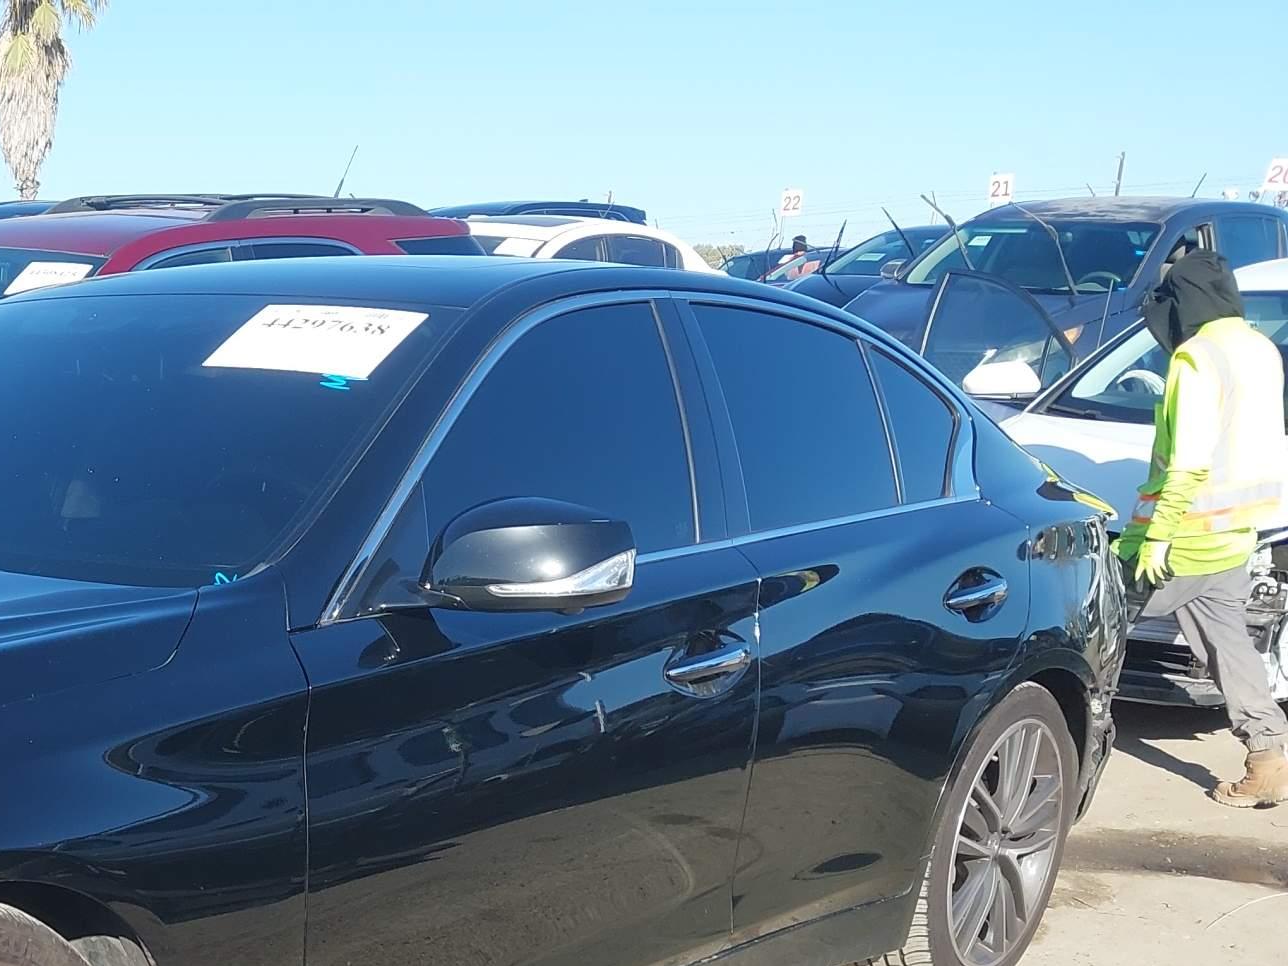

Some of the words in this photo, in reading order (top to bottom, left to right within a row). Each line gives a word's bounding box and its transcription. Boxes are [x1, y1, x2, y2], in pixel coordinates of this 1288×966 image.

[991, 180, 1010, 197] 21
[783, 195, 801, 211] 22
[262, 317, 391, 335] 44297638
